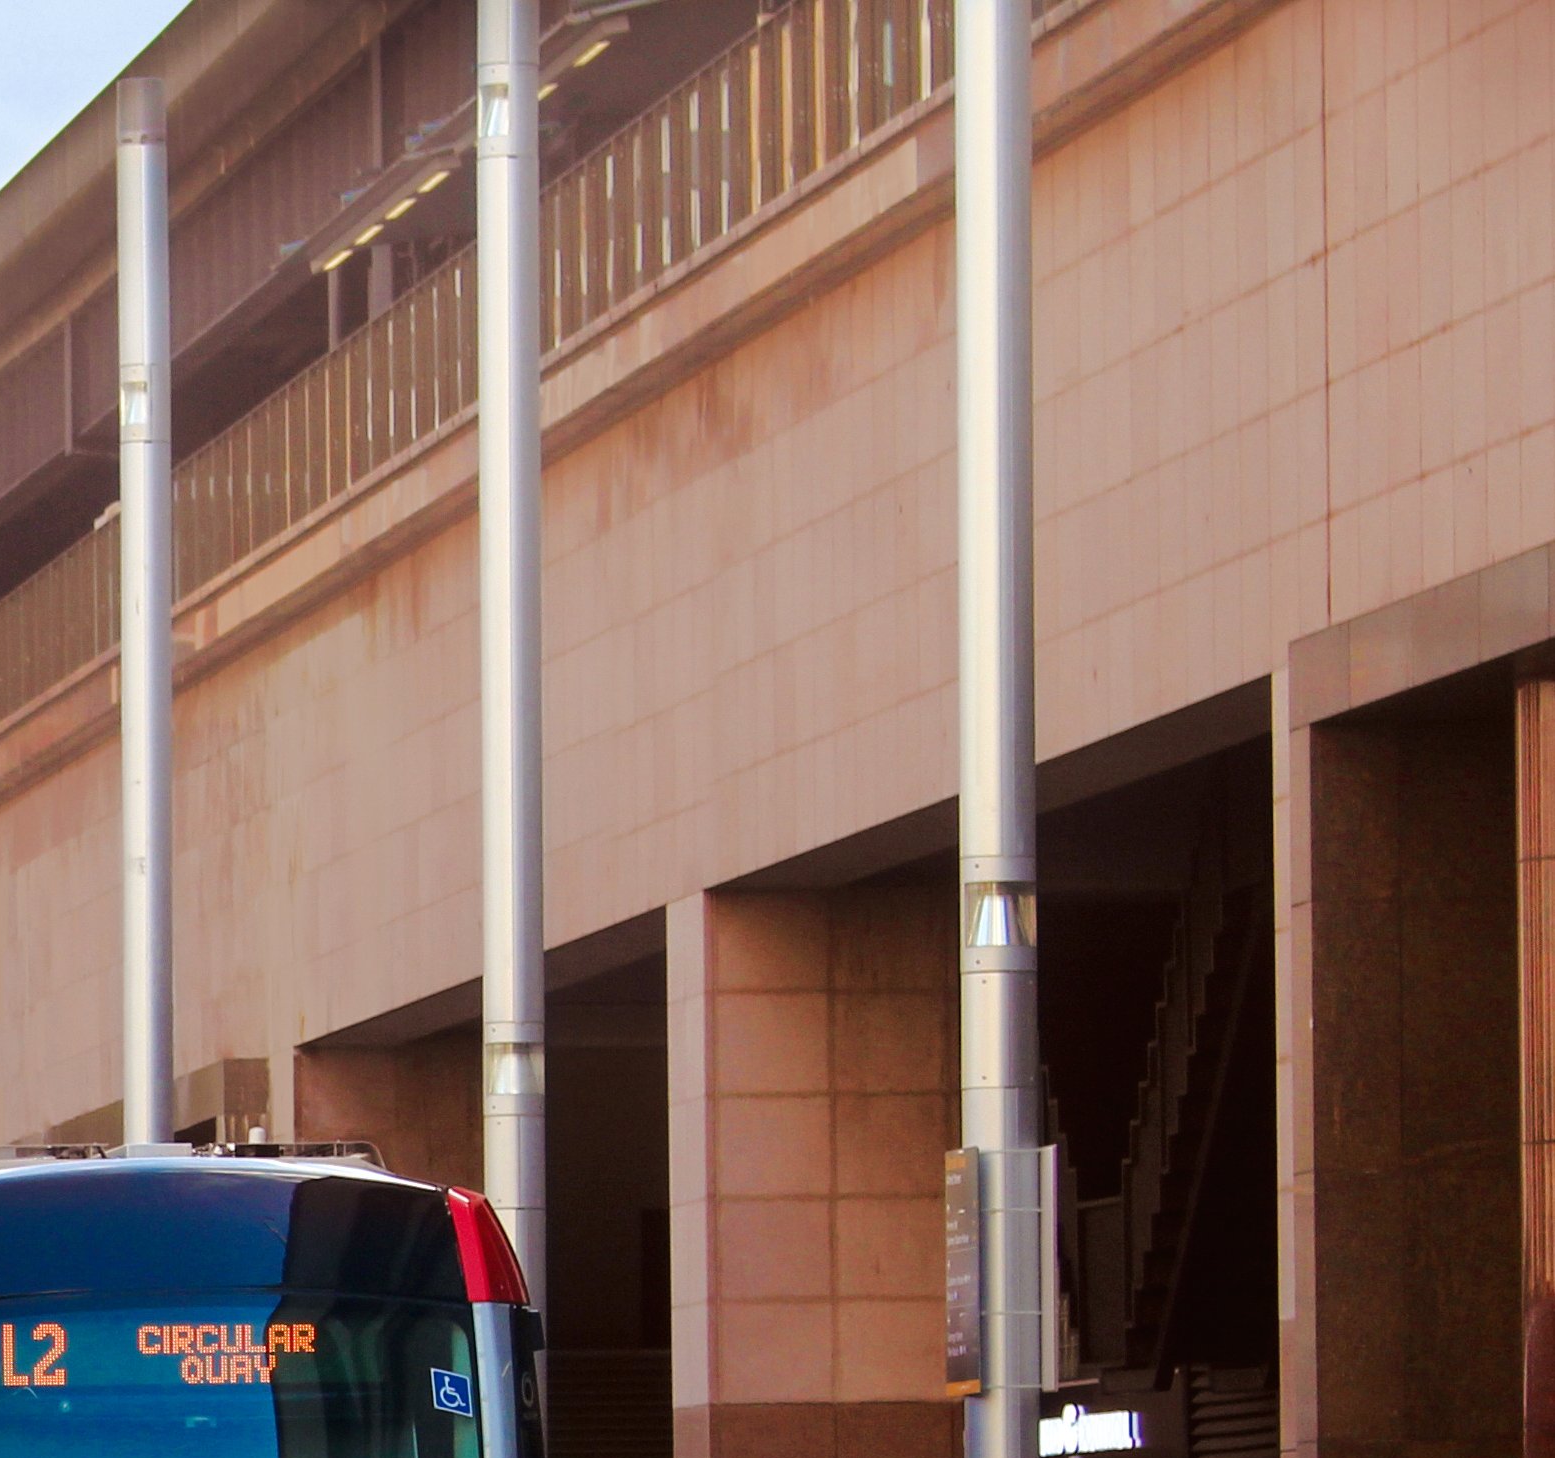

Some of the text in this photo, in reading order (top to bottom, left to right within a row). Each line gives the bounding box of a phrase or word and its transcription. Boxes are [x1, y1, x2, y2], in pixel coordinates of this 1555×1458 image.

[138, 1324, 316, 1354] CIRCULAR
[1, 1323, 66, 1386] L2
[180, 1354, 277, 1384] QUAY
